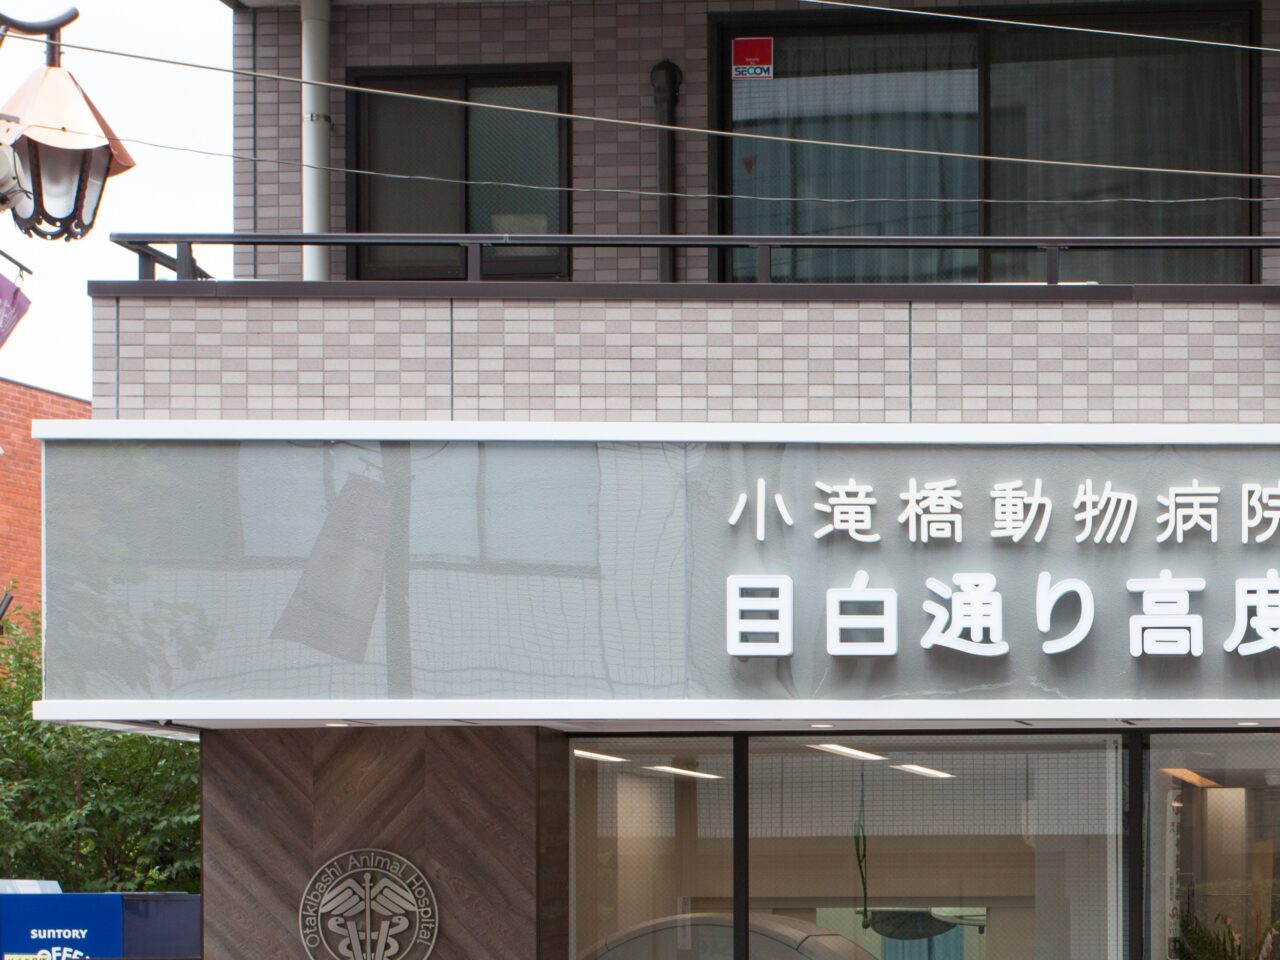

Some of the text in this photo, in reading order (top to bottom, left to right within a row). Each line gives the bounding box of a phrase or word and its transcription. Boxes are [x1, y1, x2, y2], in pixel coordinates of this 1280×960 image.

[735, 66, 770, 76] SECOM
[303, 852, 436, 948] Otakibashi Animal Hospital
